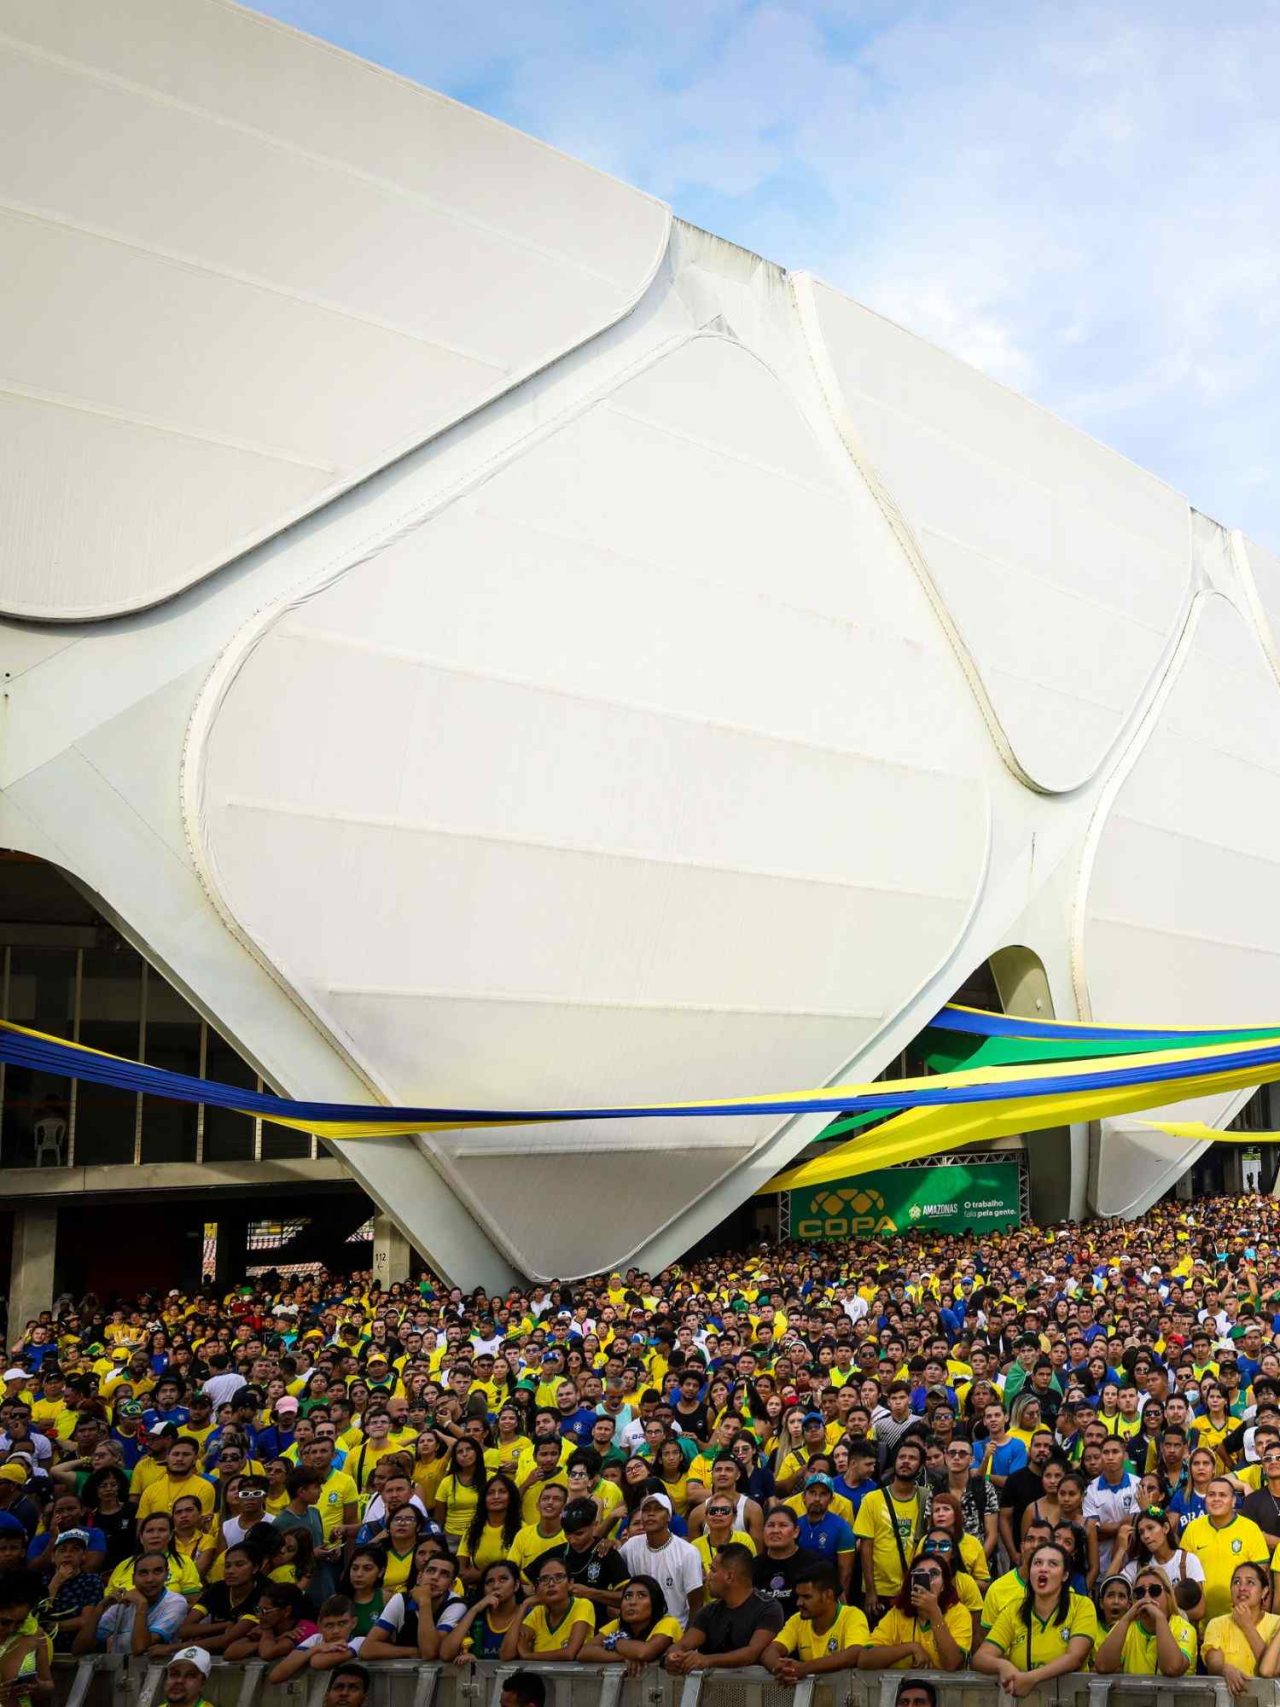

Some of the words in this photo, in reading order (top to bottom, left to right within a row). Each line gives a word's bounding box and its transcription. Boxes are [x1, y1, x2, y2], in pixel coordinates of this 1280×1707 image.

[923, 1203, 958, 1215] AMAZONAS
[964, 1201, 971, 1209] O
[972, 1200, 1004, 1209] trabalho
[977, 1208, 993, 1218] pela
[798, 1215, 898, 1237] COPA
